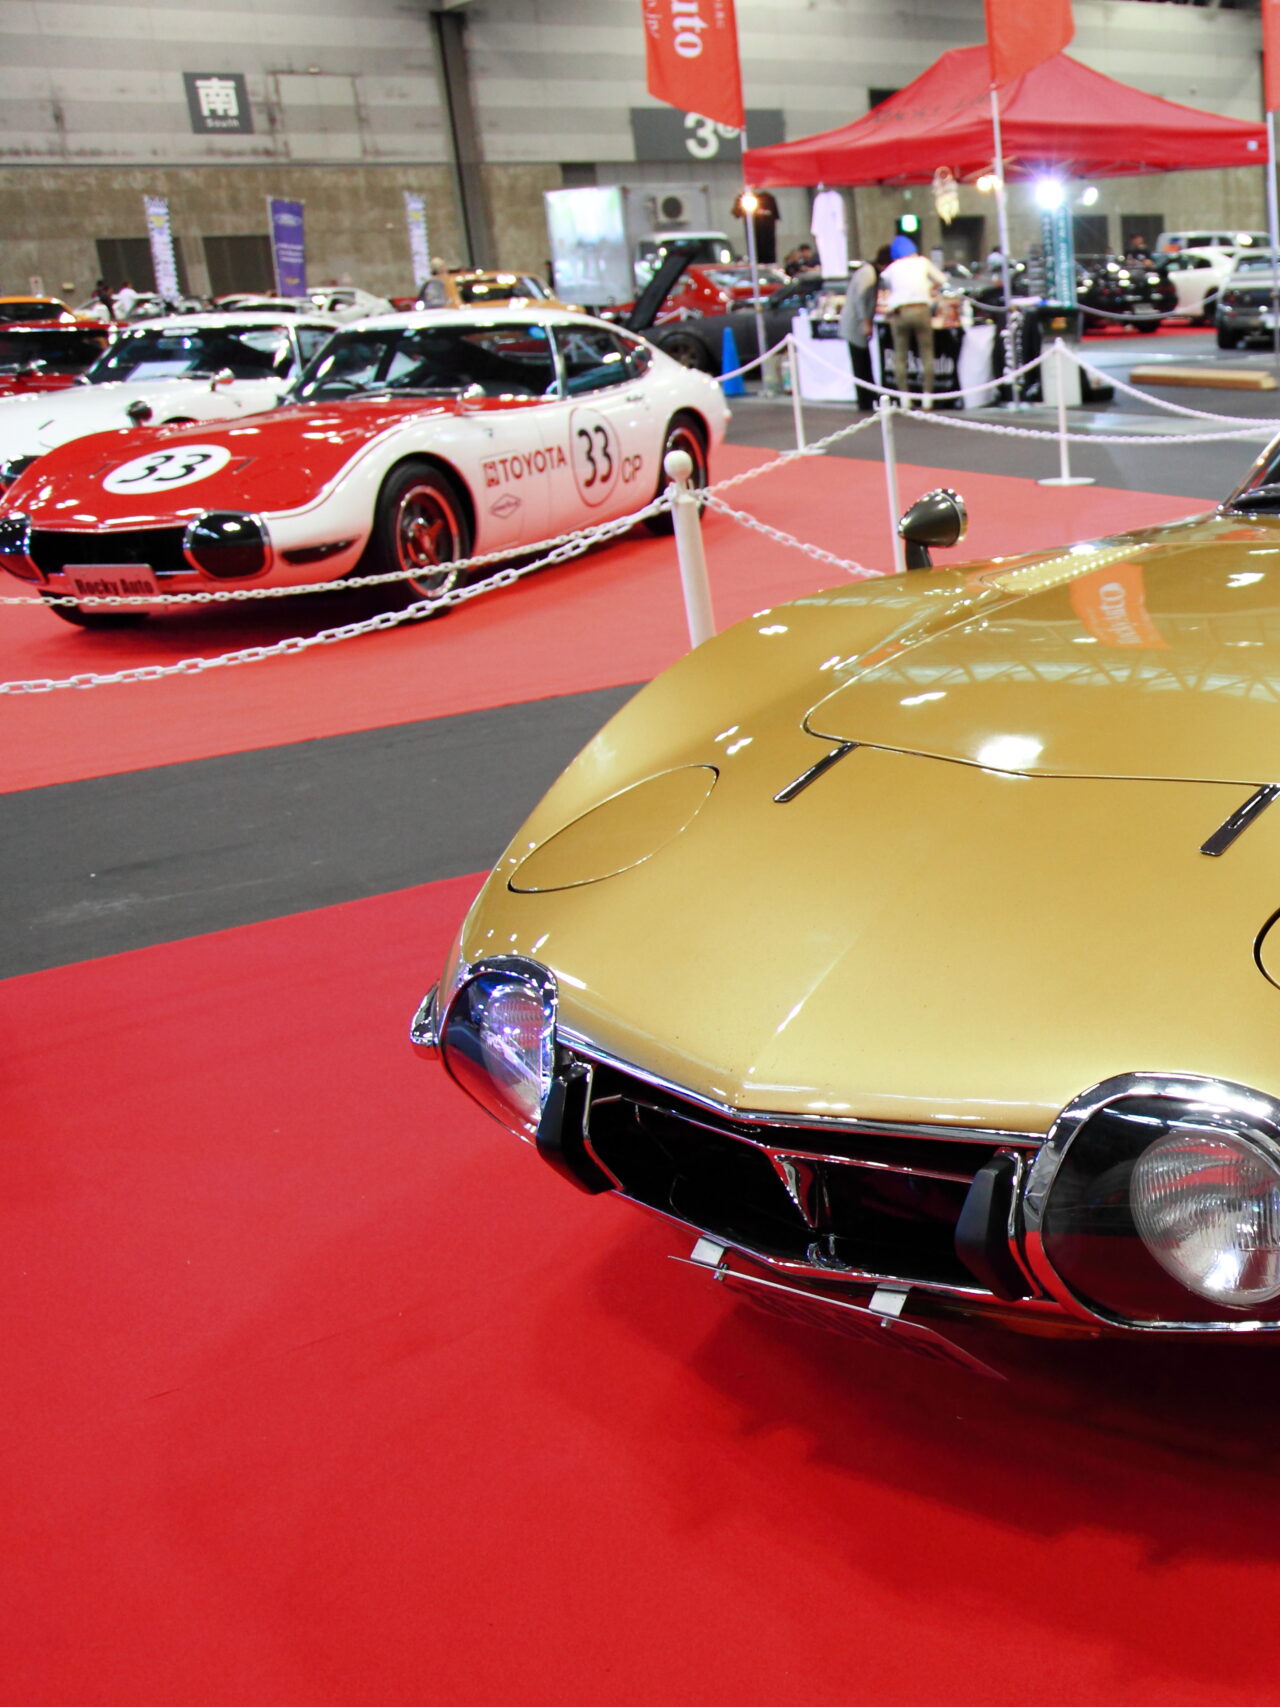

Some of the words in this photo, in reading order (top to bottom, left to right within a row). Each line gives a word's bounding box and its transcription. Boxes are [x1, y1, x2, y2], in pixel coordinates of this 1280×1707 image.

[194, 77, 240, 117] 南
[116, 453, 213, 484] 33
[499, 446, 567, 482] TOYOTA
[577, 425, 613, 488] 33
[74, 579, 121, 596] Rocky
[120, 579, 154, 594] Auto
